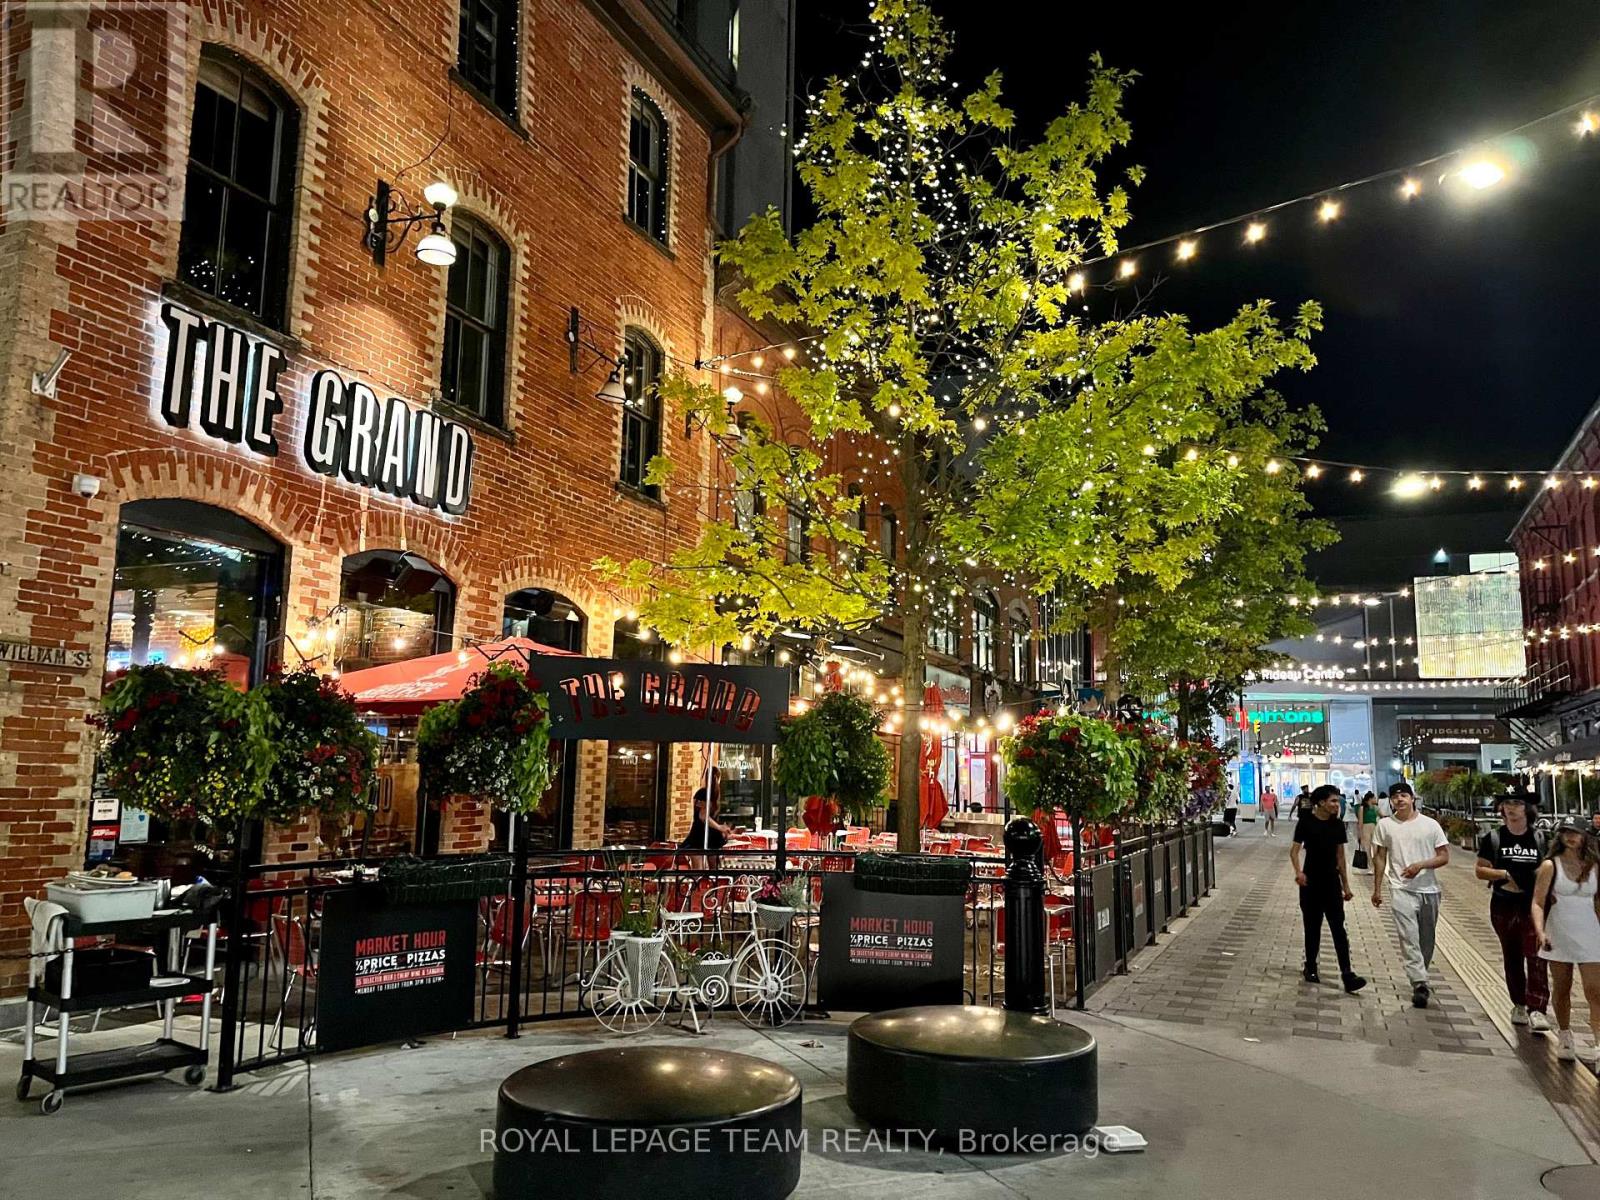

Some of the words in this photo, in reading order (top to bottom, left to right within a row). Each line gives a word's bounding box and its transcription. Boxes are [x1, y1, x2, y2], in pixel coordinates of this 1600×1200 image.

[161, 303, 287, 457] THE
[304, 370, 474, 515] GRAND
[1303, 668, 1345, 680] Centre
[559, 670, 626, 724] THE
[640, 670, 761, 732] GRAND
[849, 917, 898, 934] MARKET
[903, 919, 934, 935] HOUR
[355, 934, 409, 956] MARKET
[413, 930, 447, 948] HOUR
[897, 936, 934, 947] PIZZAS
[406, 949, 446, 964] PIZZAS
